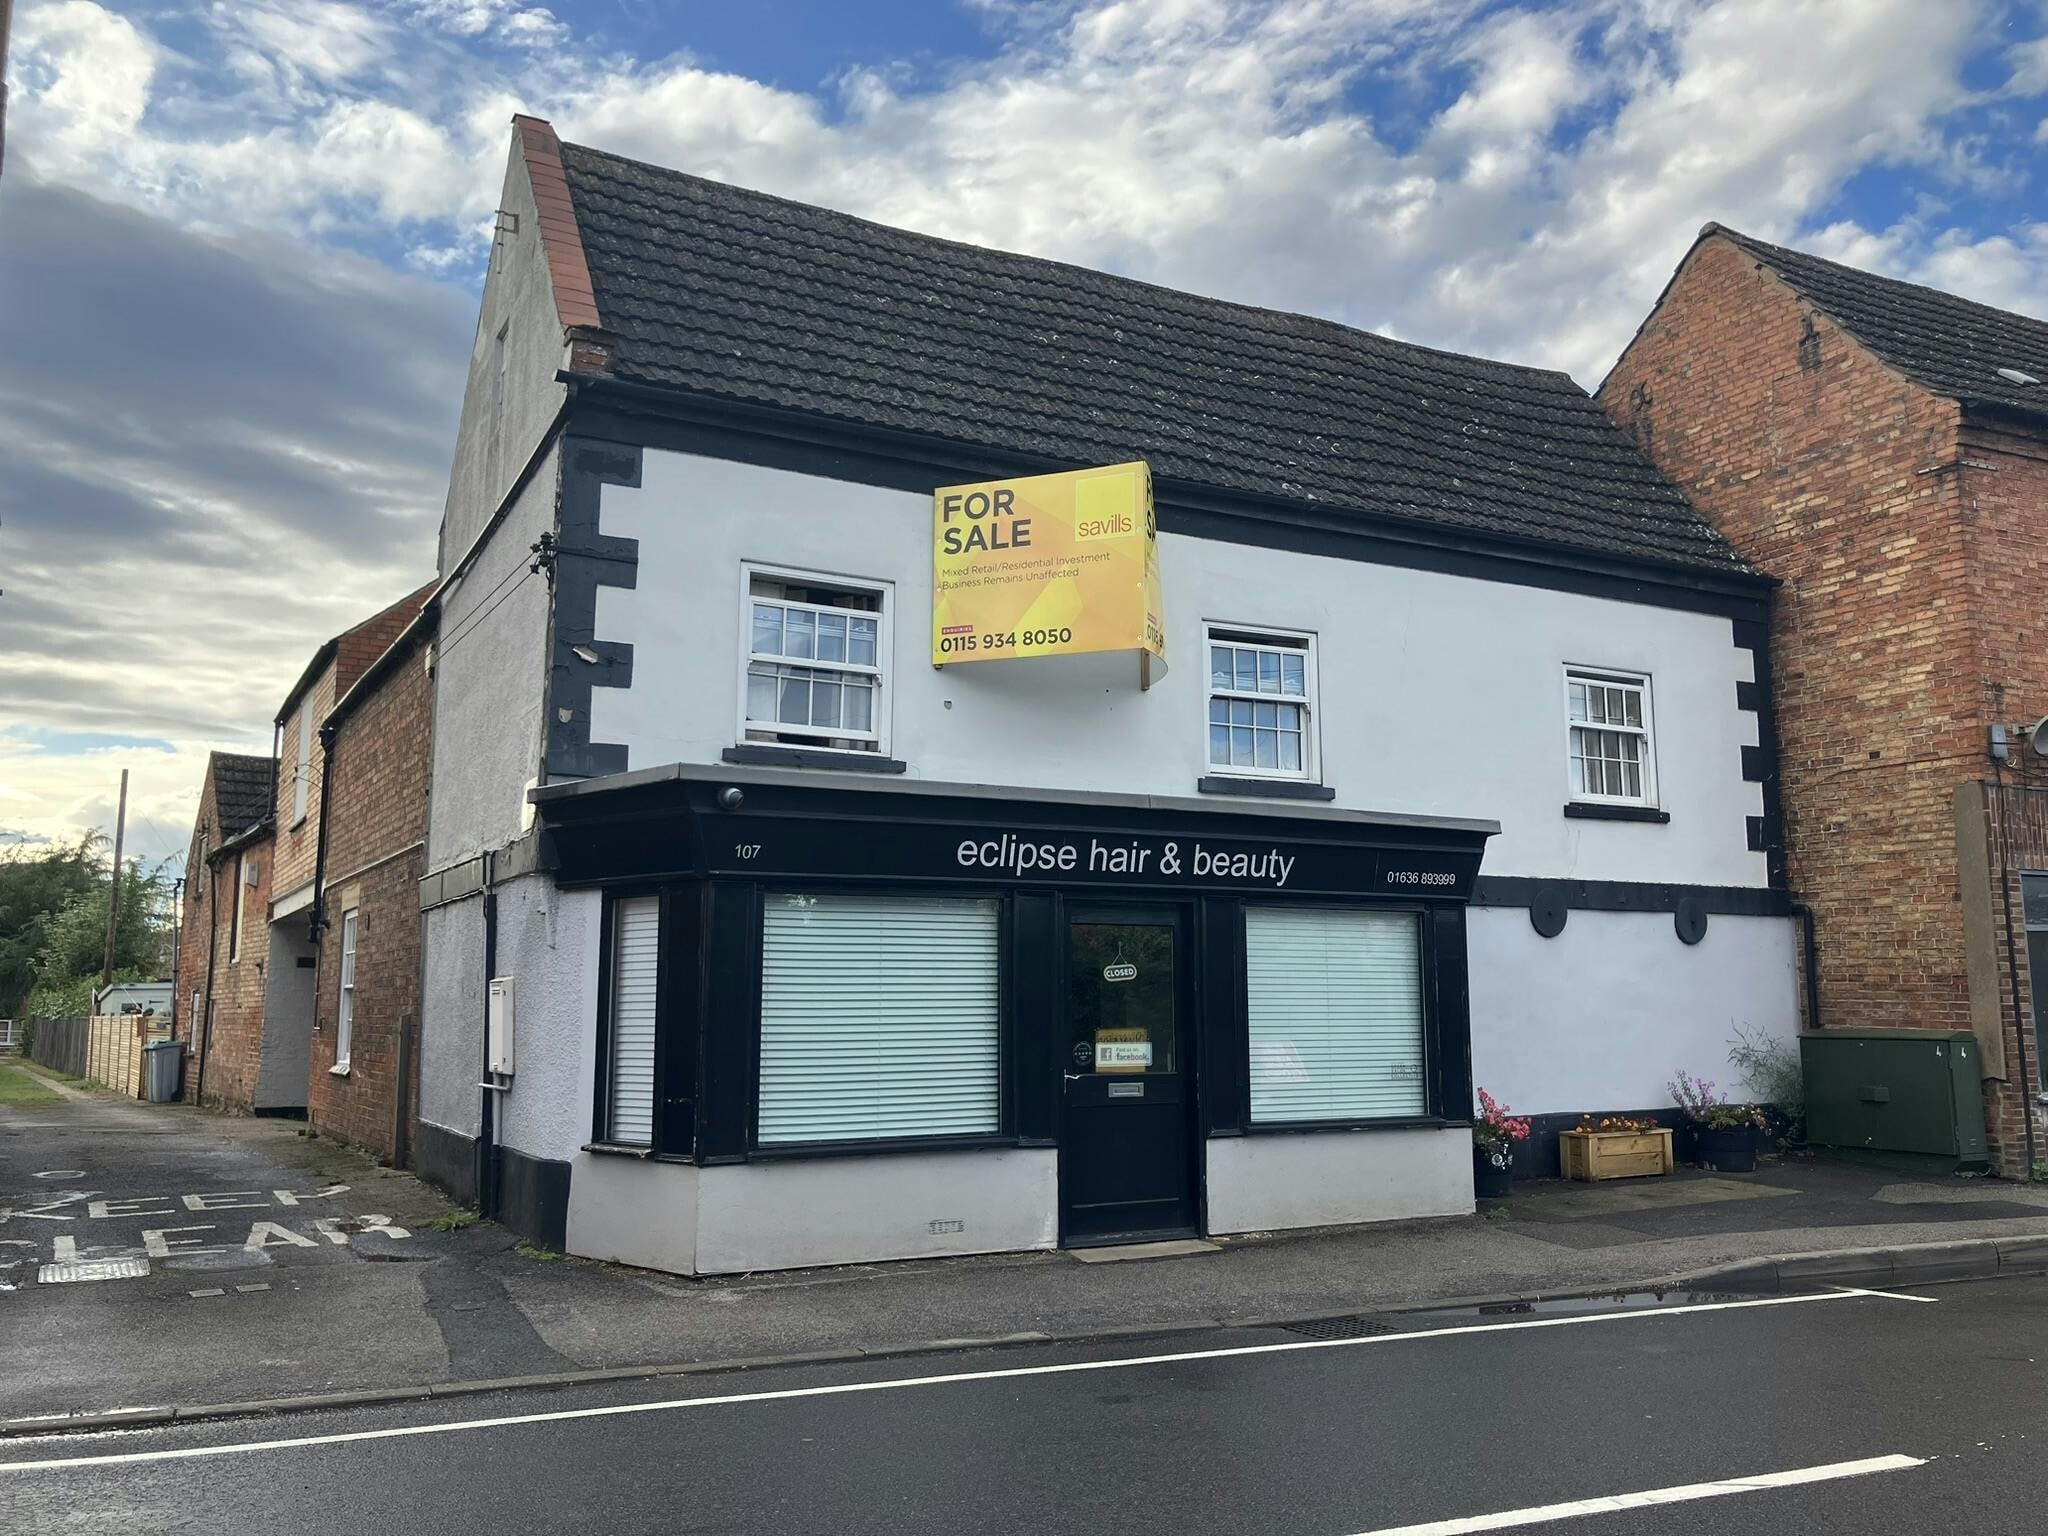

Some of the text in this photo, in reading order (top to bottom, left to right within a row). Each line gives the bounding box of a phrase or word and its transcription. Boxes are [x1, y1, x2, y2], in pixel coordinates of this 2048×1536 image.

[943, 489, 1015, 523] FOR
[943, 519, 1031, 555] SALE
[1078, 514, 1132, 537] savills
[942, 552, 1111, 578] Mixed Retail/Residential Investment
[942, 567, 1080, 591] Business Remains Unaffected
[940, 627, 1072, 653] 0115 934 8050
[734, 844, 761, 859] 107
[956, 834, 1295, 887] eclipse hair & beauty
[1387, 871, 1456, 885] 01636 893999
[1106, 968, 1134, 978] CLOSED
[0, 1185, 351, 1223] KEEP
